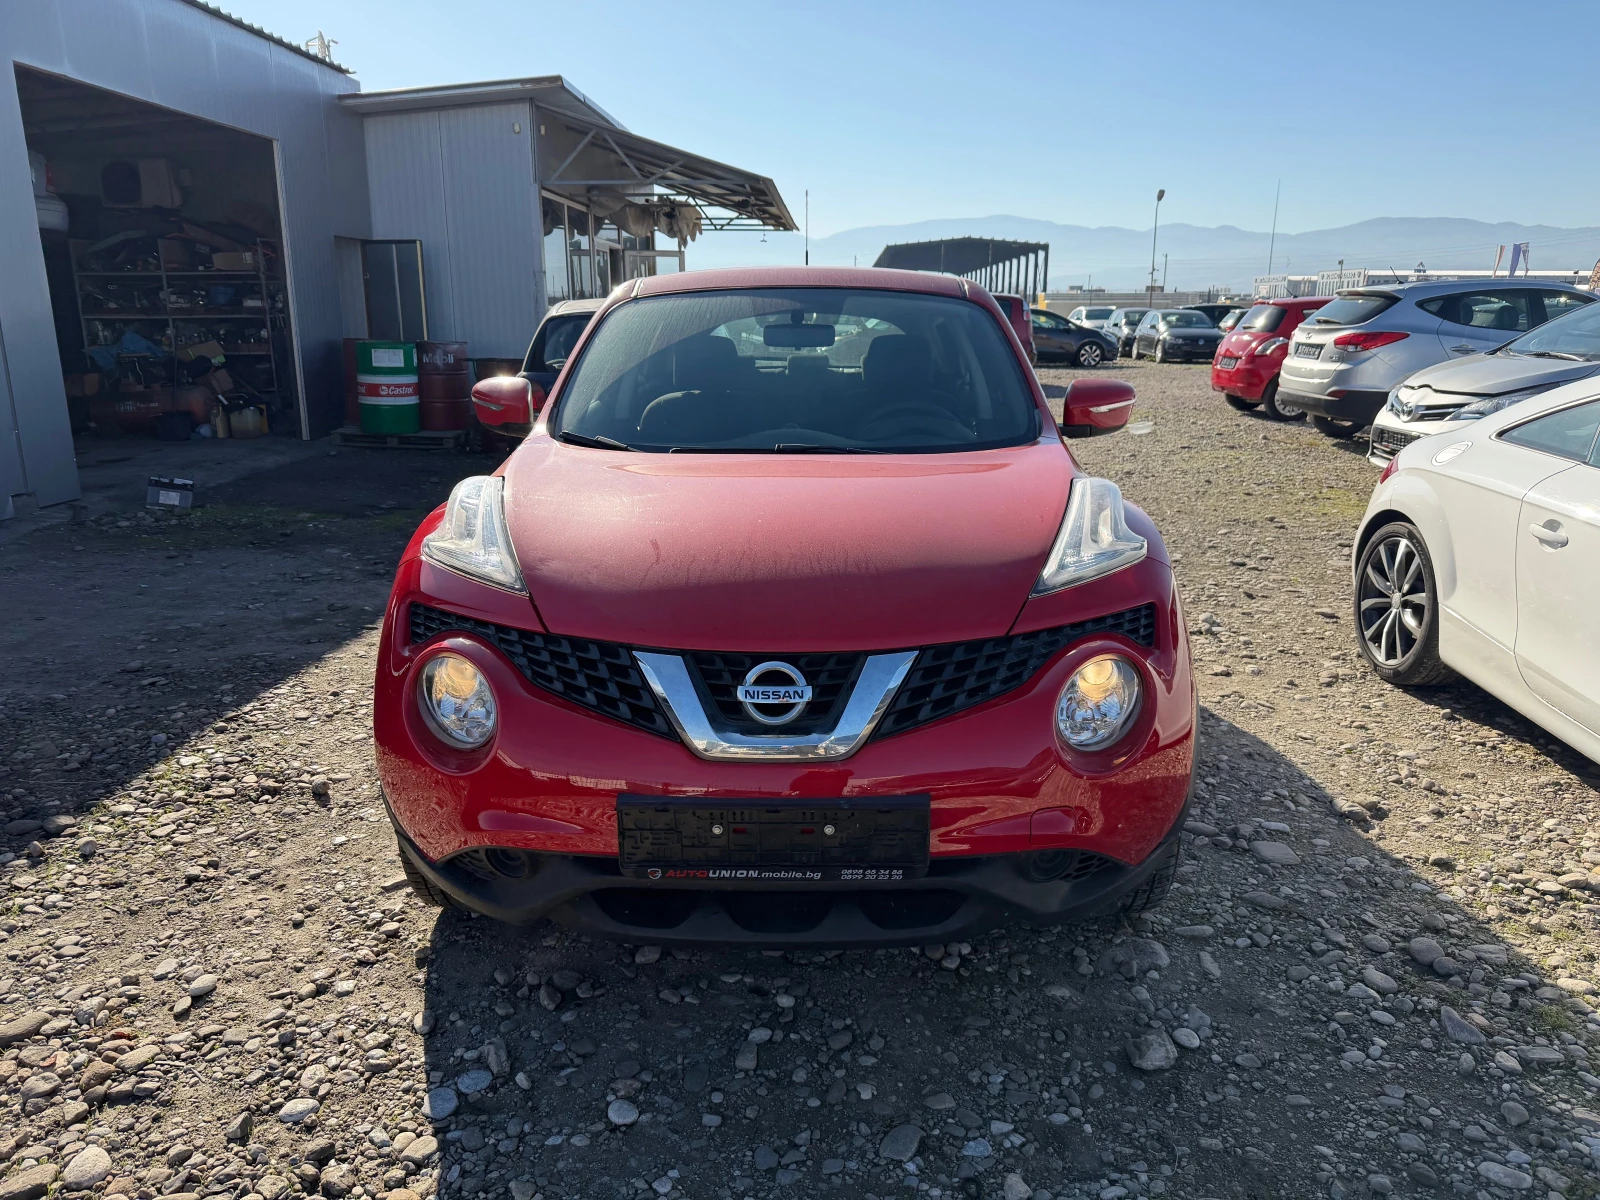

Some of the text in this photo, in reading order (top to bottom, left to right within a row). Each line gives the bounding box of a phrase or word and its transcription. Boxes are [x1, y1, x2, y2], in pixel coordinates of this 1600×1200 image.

[388, 385, 414, 395] Castrol
[744, 689, 804, 700] NISSAN
[665, 869, 822, 880] AUTOUNION.mobile.bg
